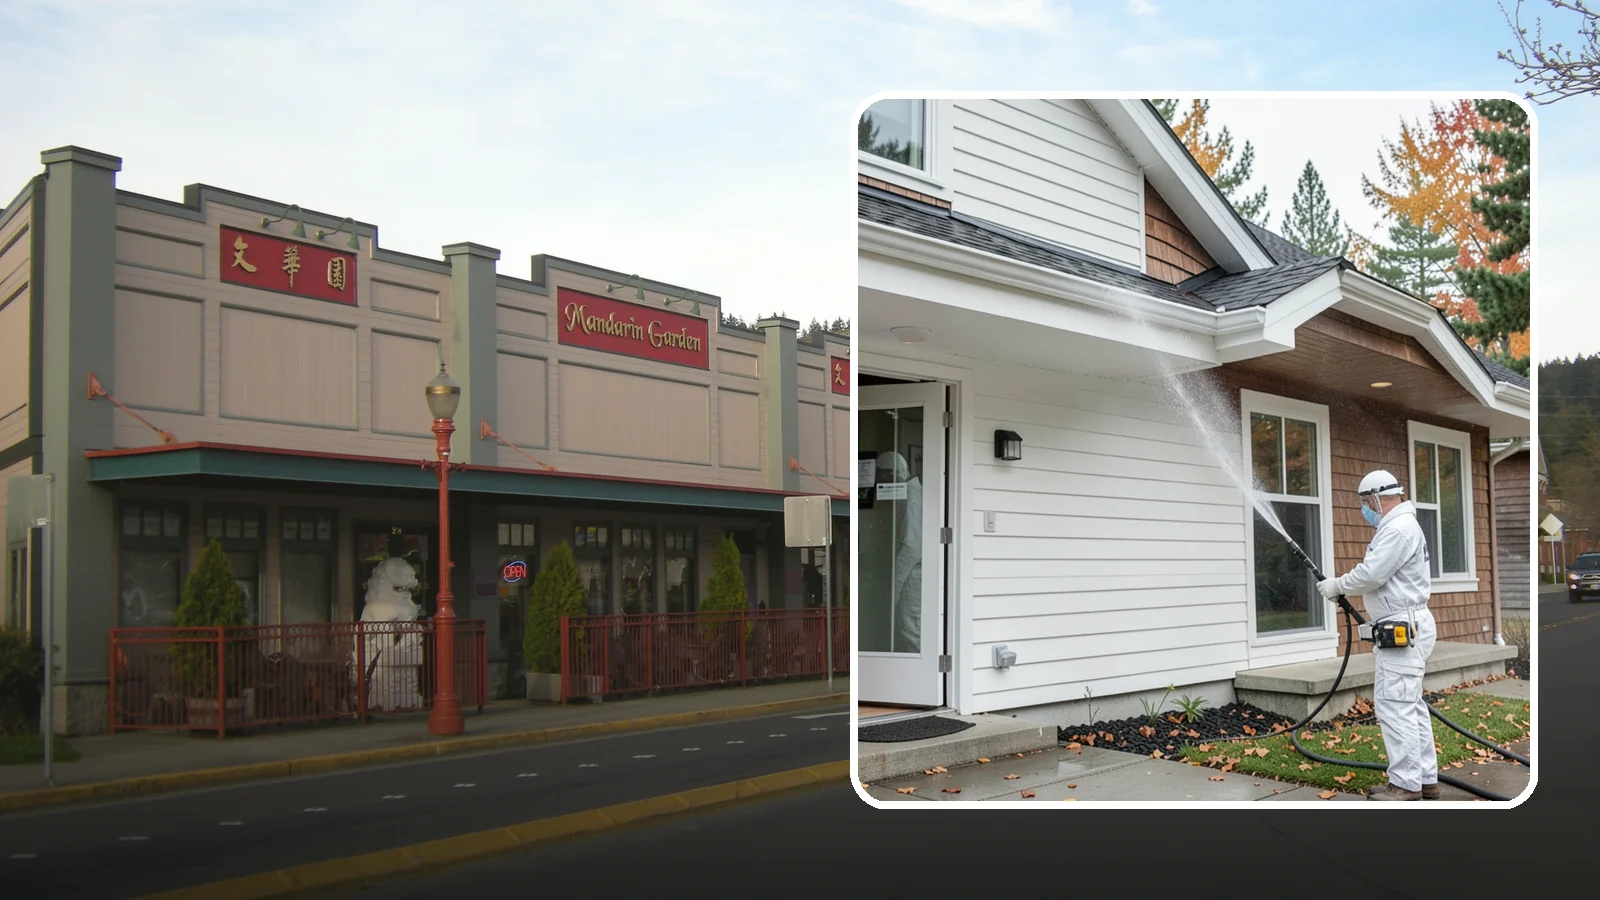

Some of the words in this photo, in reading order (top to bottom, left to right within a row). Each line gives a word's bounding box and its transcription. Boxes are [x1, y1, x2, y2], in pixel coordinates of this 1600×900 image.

[564, 302, 644, 341] Mandarin
[647, 320, 701, 352] Garden
[503, 565, 527, 578] OPEN
